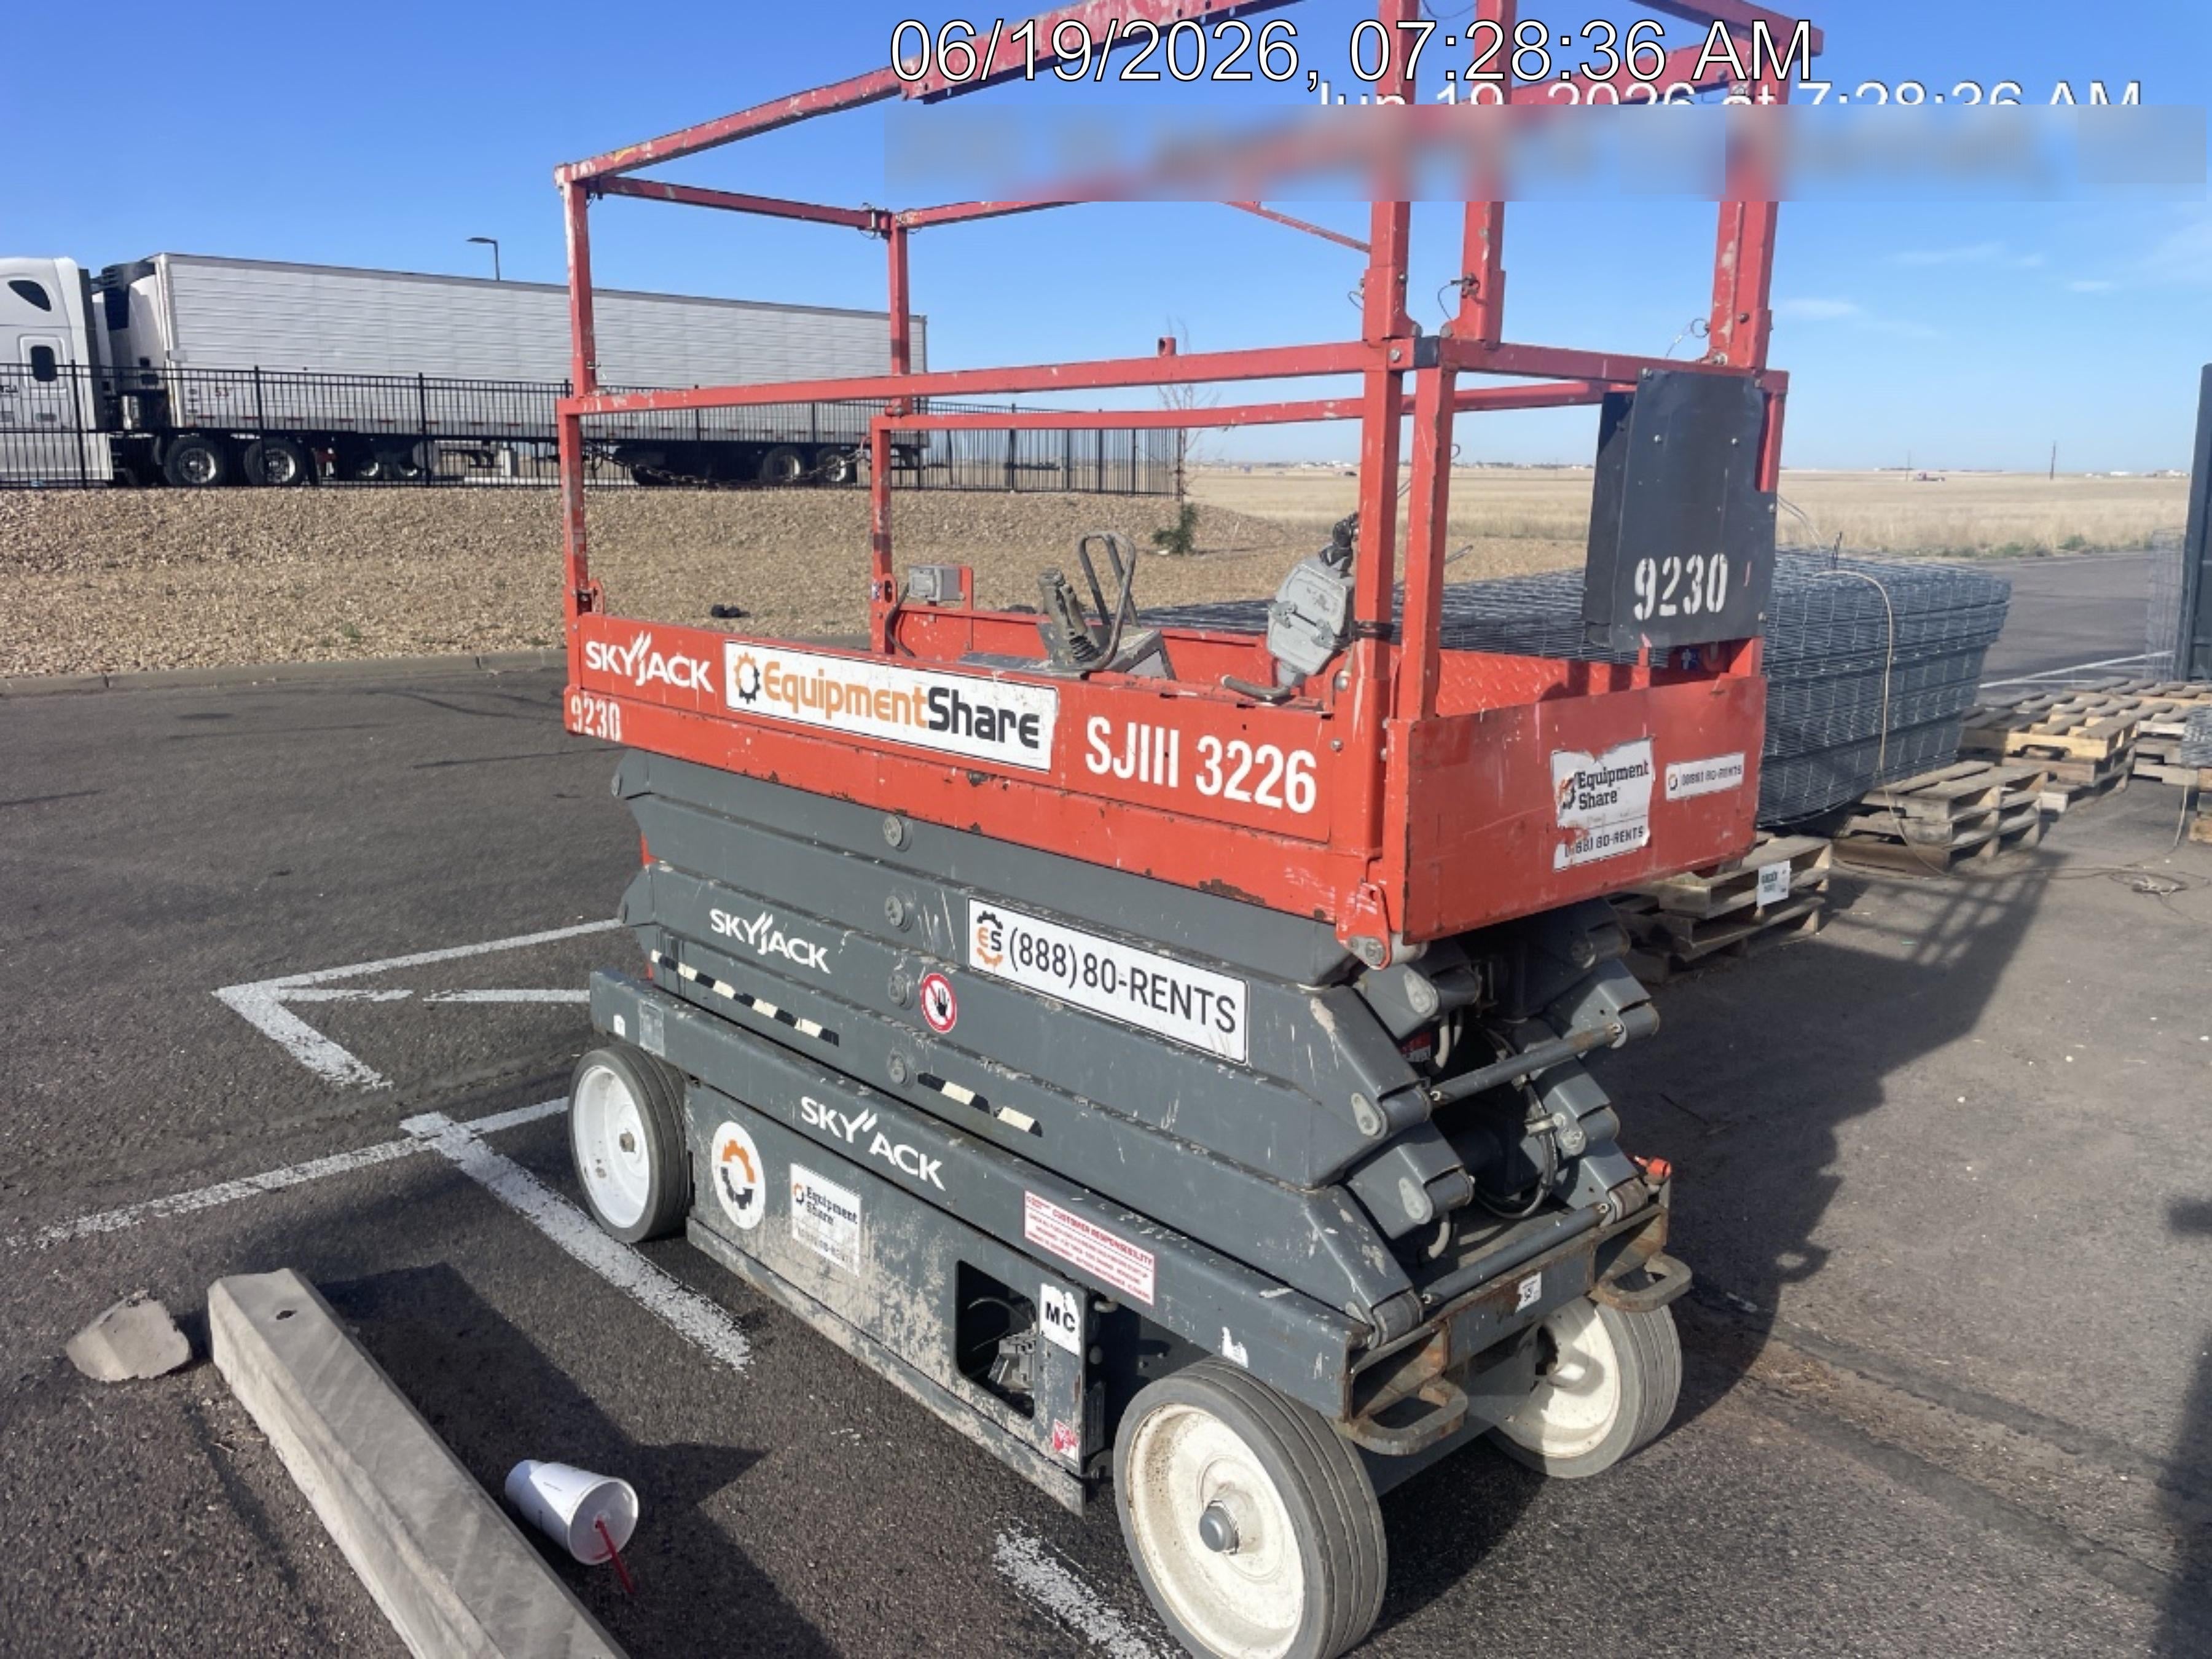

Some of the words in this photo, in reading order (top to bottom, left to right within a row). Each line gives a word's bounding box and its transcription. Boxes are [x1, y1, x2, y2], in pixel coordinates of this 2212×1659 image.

[1633, 553, 1729, 621] 9230
[585, 630, 715, 693] SKYJACK
[570, 694, 622, 742] 9230
[764, 661, 1040, 749] EquipmentShare
[1085, 716, 1180, 788] SJIII
[1195, 735, 1317, 814] 3226
[1575, 759, 1649, 790] Equipment
[1579, 790, 1618, 810] Share
[709, 908, 832, 974] SKYJACK
